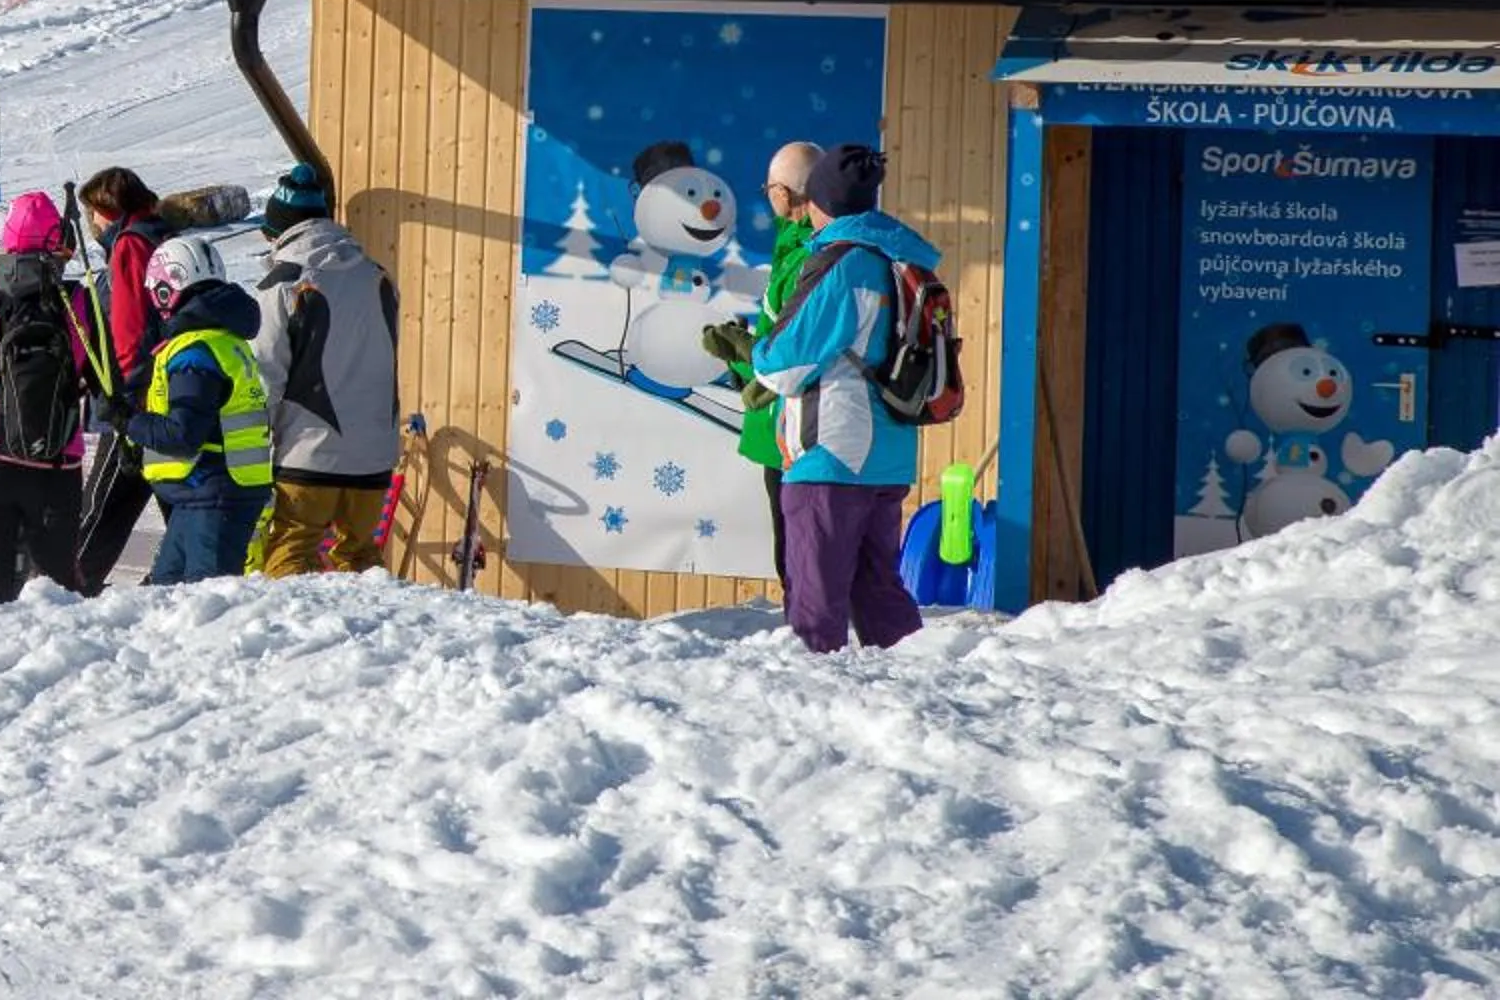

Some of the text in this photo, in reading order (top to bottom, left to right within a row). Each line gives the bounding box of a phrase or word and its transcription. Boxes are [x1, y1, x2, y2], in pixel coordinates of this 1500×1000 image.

[1145, 95, 1232, 125] ŠKOLA
[1253, 94, 1396, 128] PŮJČOVNA
[1202, 144, 1417, 179] Sport Šumava
[1200, 200, 1338, 222] lyžařská škola
[1200, 228, 1406, 250] snowboardová škola
[1200, 254, 1403, 279] půjčovna lyžařského
[1200, 282, 1288, 303] vybavení
